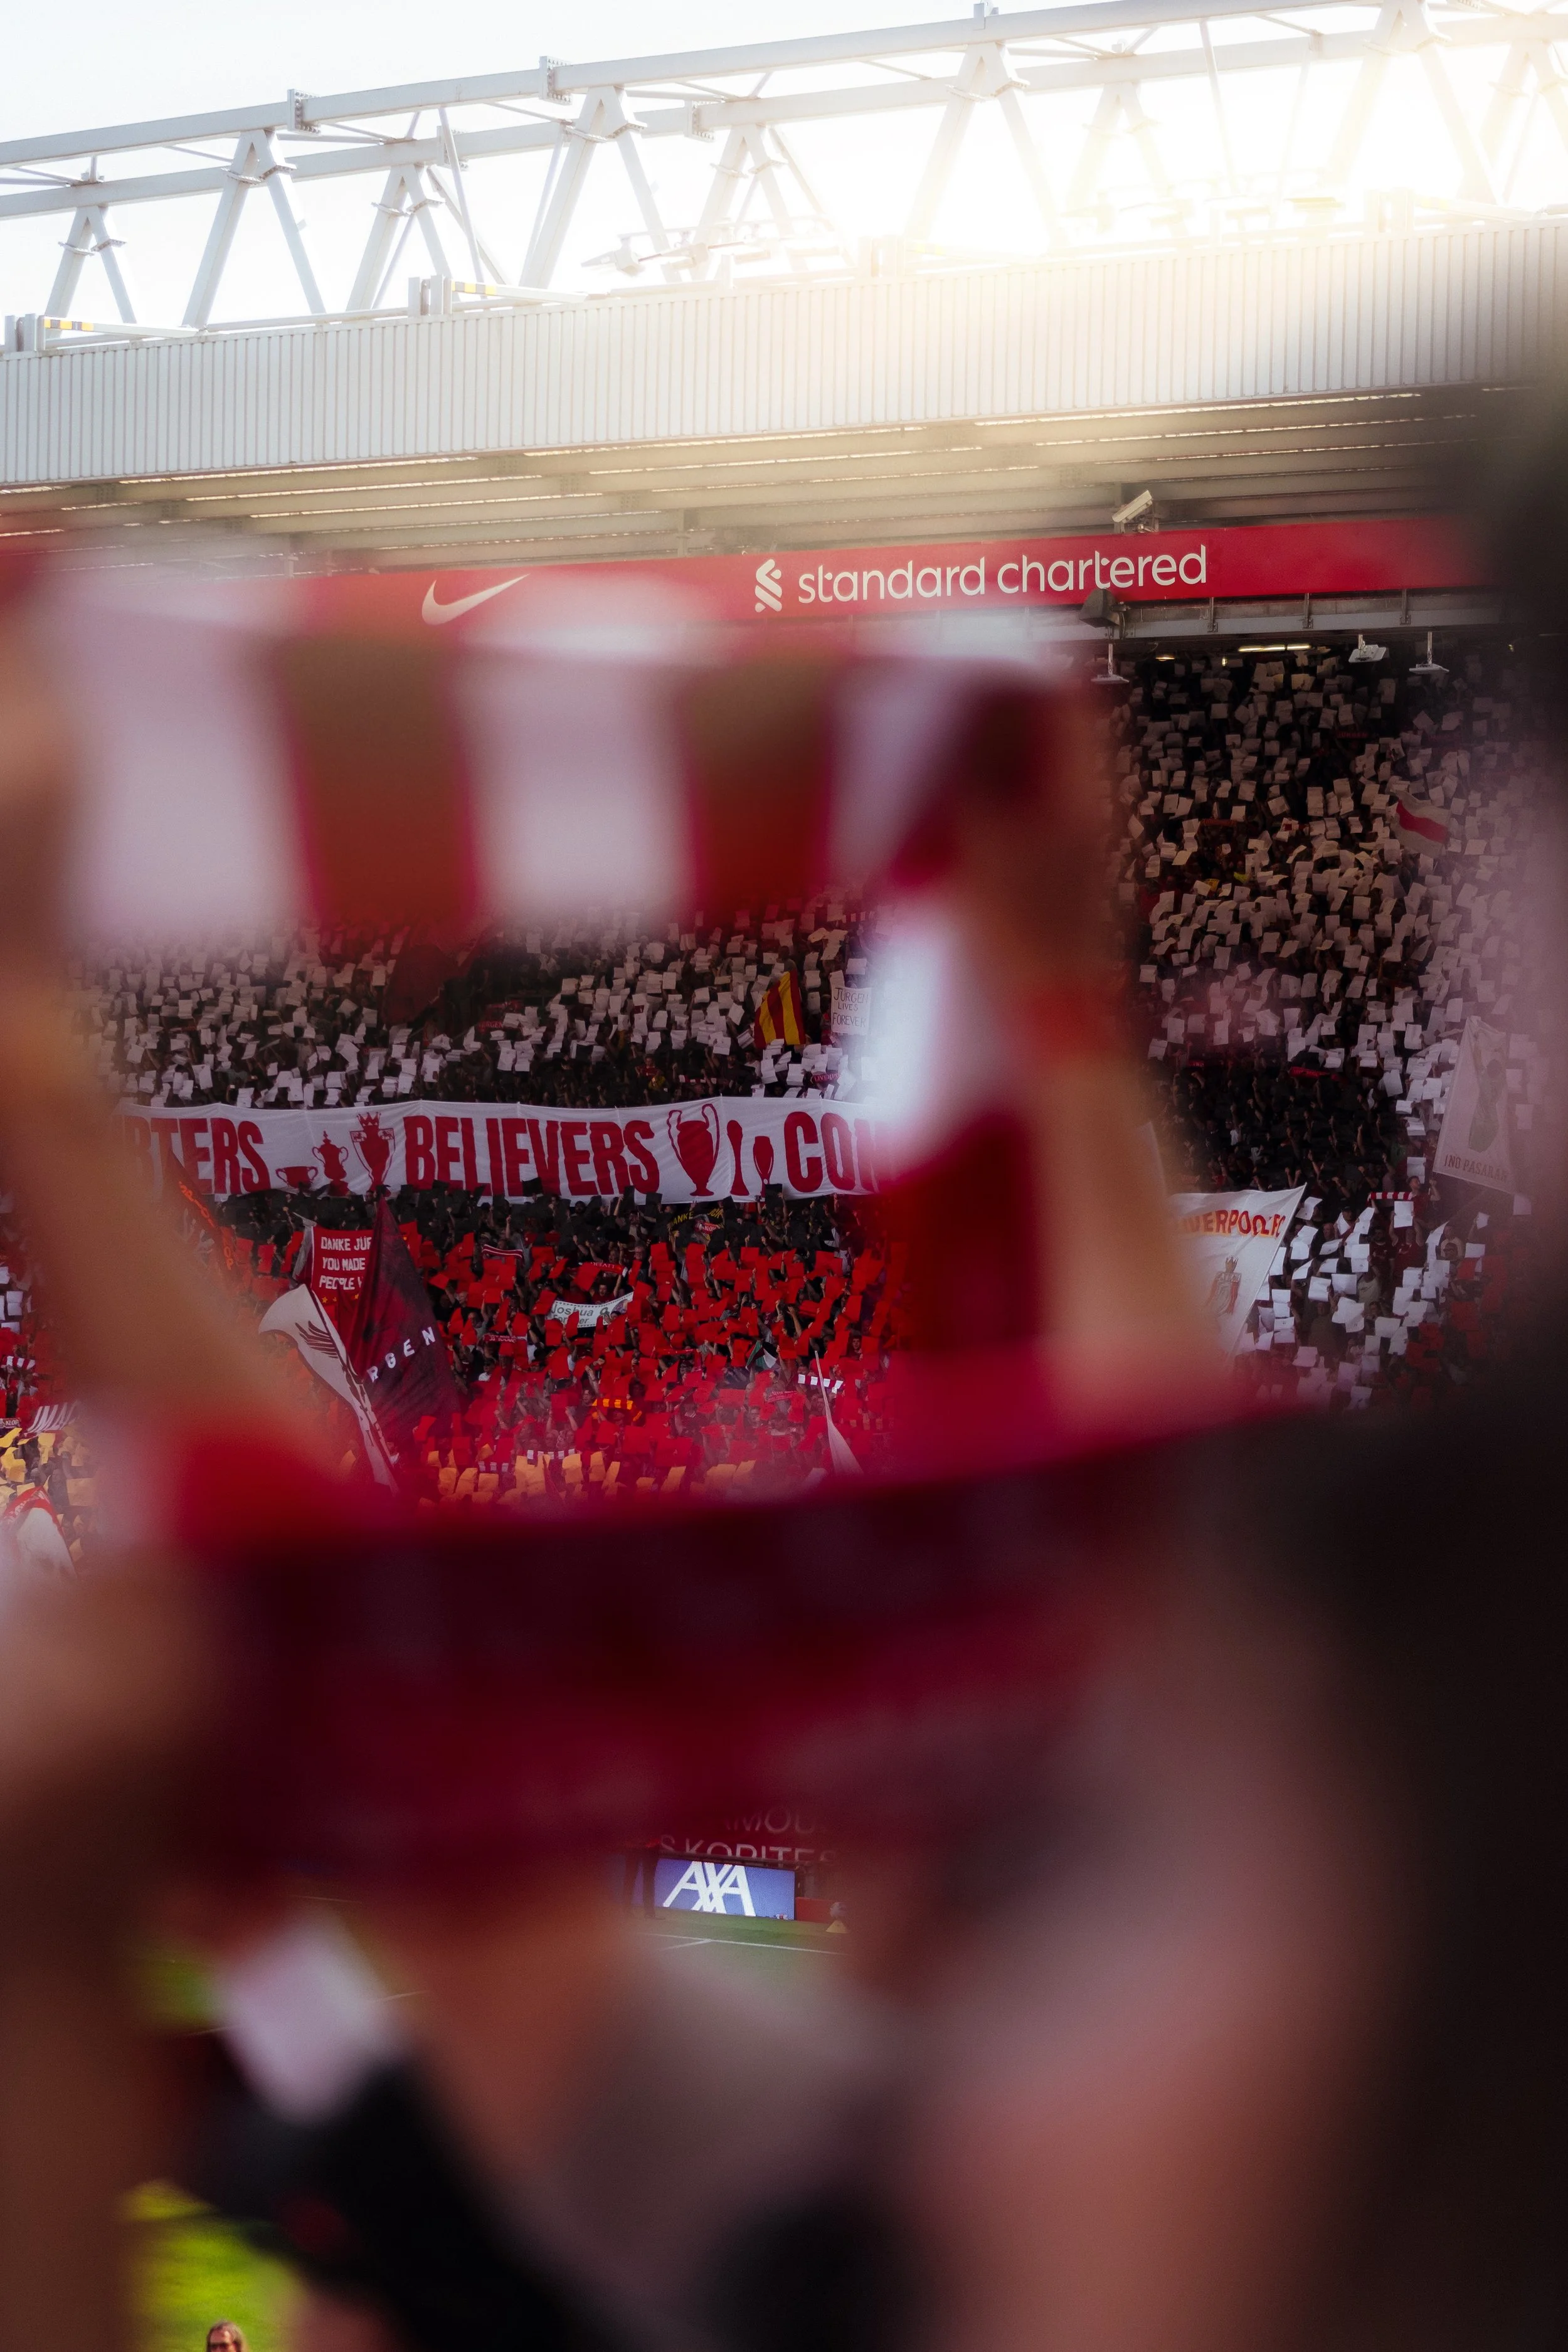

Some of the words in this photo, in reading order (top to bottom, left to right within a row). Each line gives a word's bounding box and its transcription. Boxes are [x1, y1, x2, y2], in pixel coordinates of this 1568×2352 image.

[798, 556, 985, 604] standard
[997, 544, 1207, 594] chartered
[838, 1003, 859, 1012] LIVES
[403, 1115, 660, 1196] BELIEVERS
[673, 1210, 694, 1226] ANKE
[320, 1236, 351, 1251] DANKE
[322, 1256, 341, 1271] YOU
[342, 1257, 366, 1271] MADE
[551, 1304, 594, 1317] Joshua
[366, 1326, 437, 1384] RGEN
[662, 1860, 756, 1917] AXA
